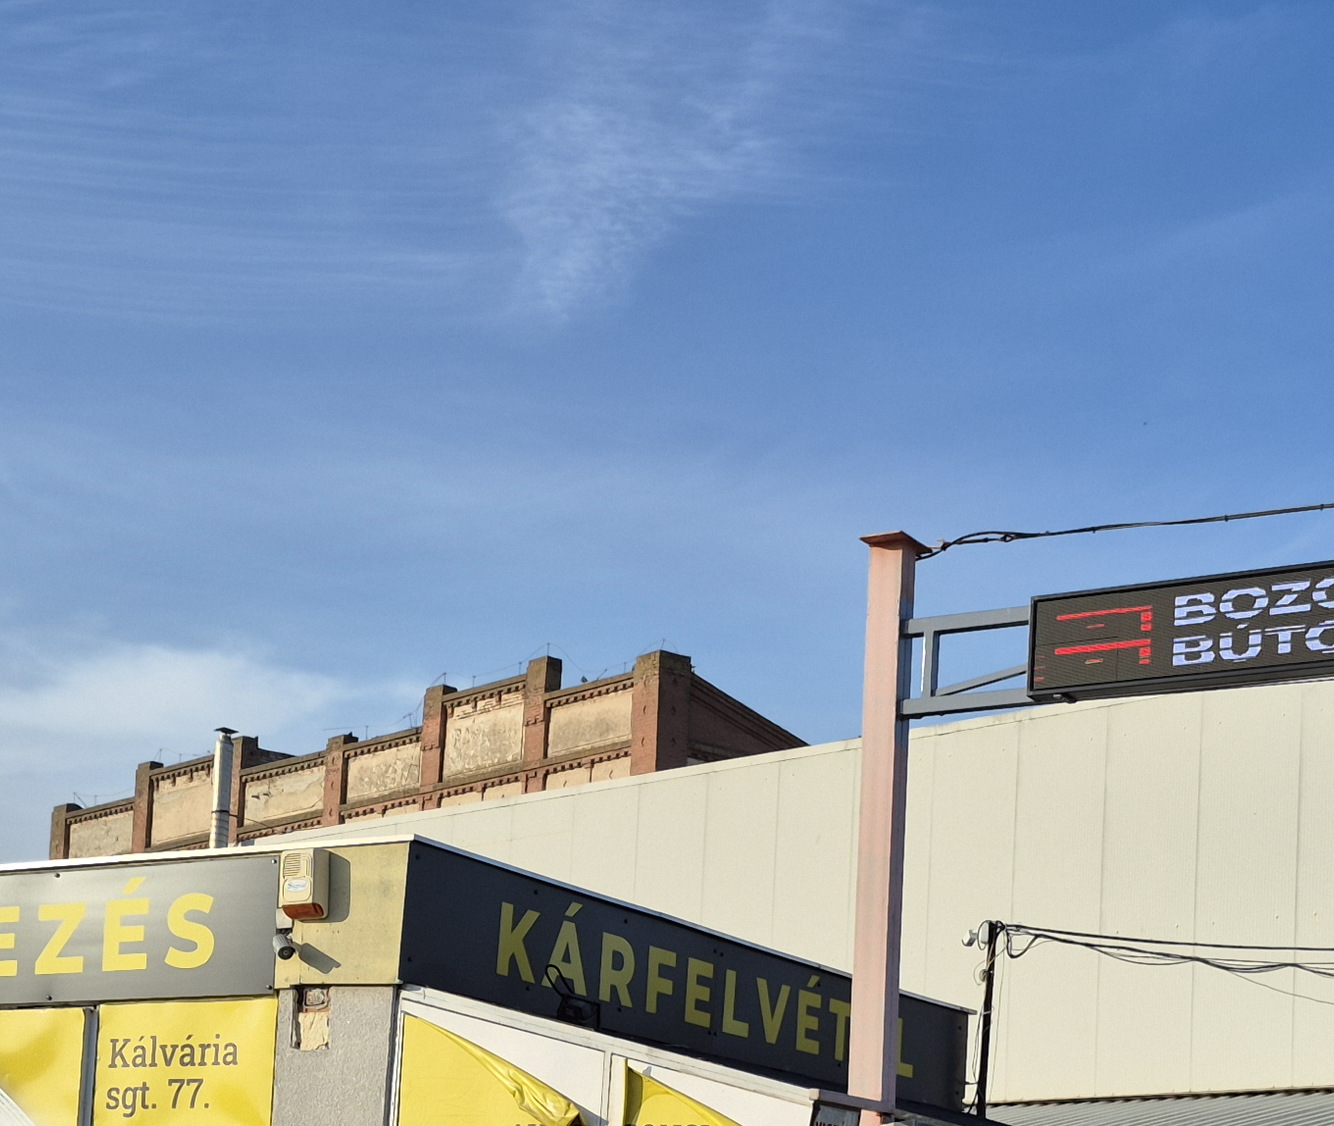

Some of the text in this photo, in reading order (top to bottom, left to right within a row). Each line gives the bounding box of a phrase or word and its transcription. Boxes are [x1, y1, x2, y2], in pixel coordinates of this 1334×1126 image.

[495, 900, 914, 1079] KÁRFELVÉTL
[108, 1033, 239, 1069] Kálvária
[105, 1077, 211, 1118] sgt. 77.
